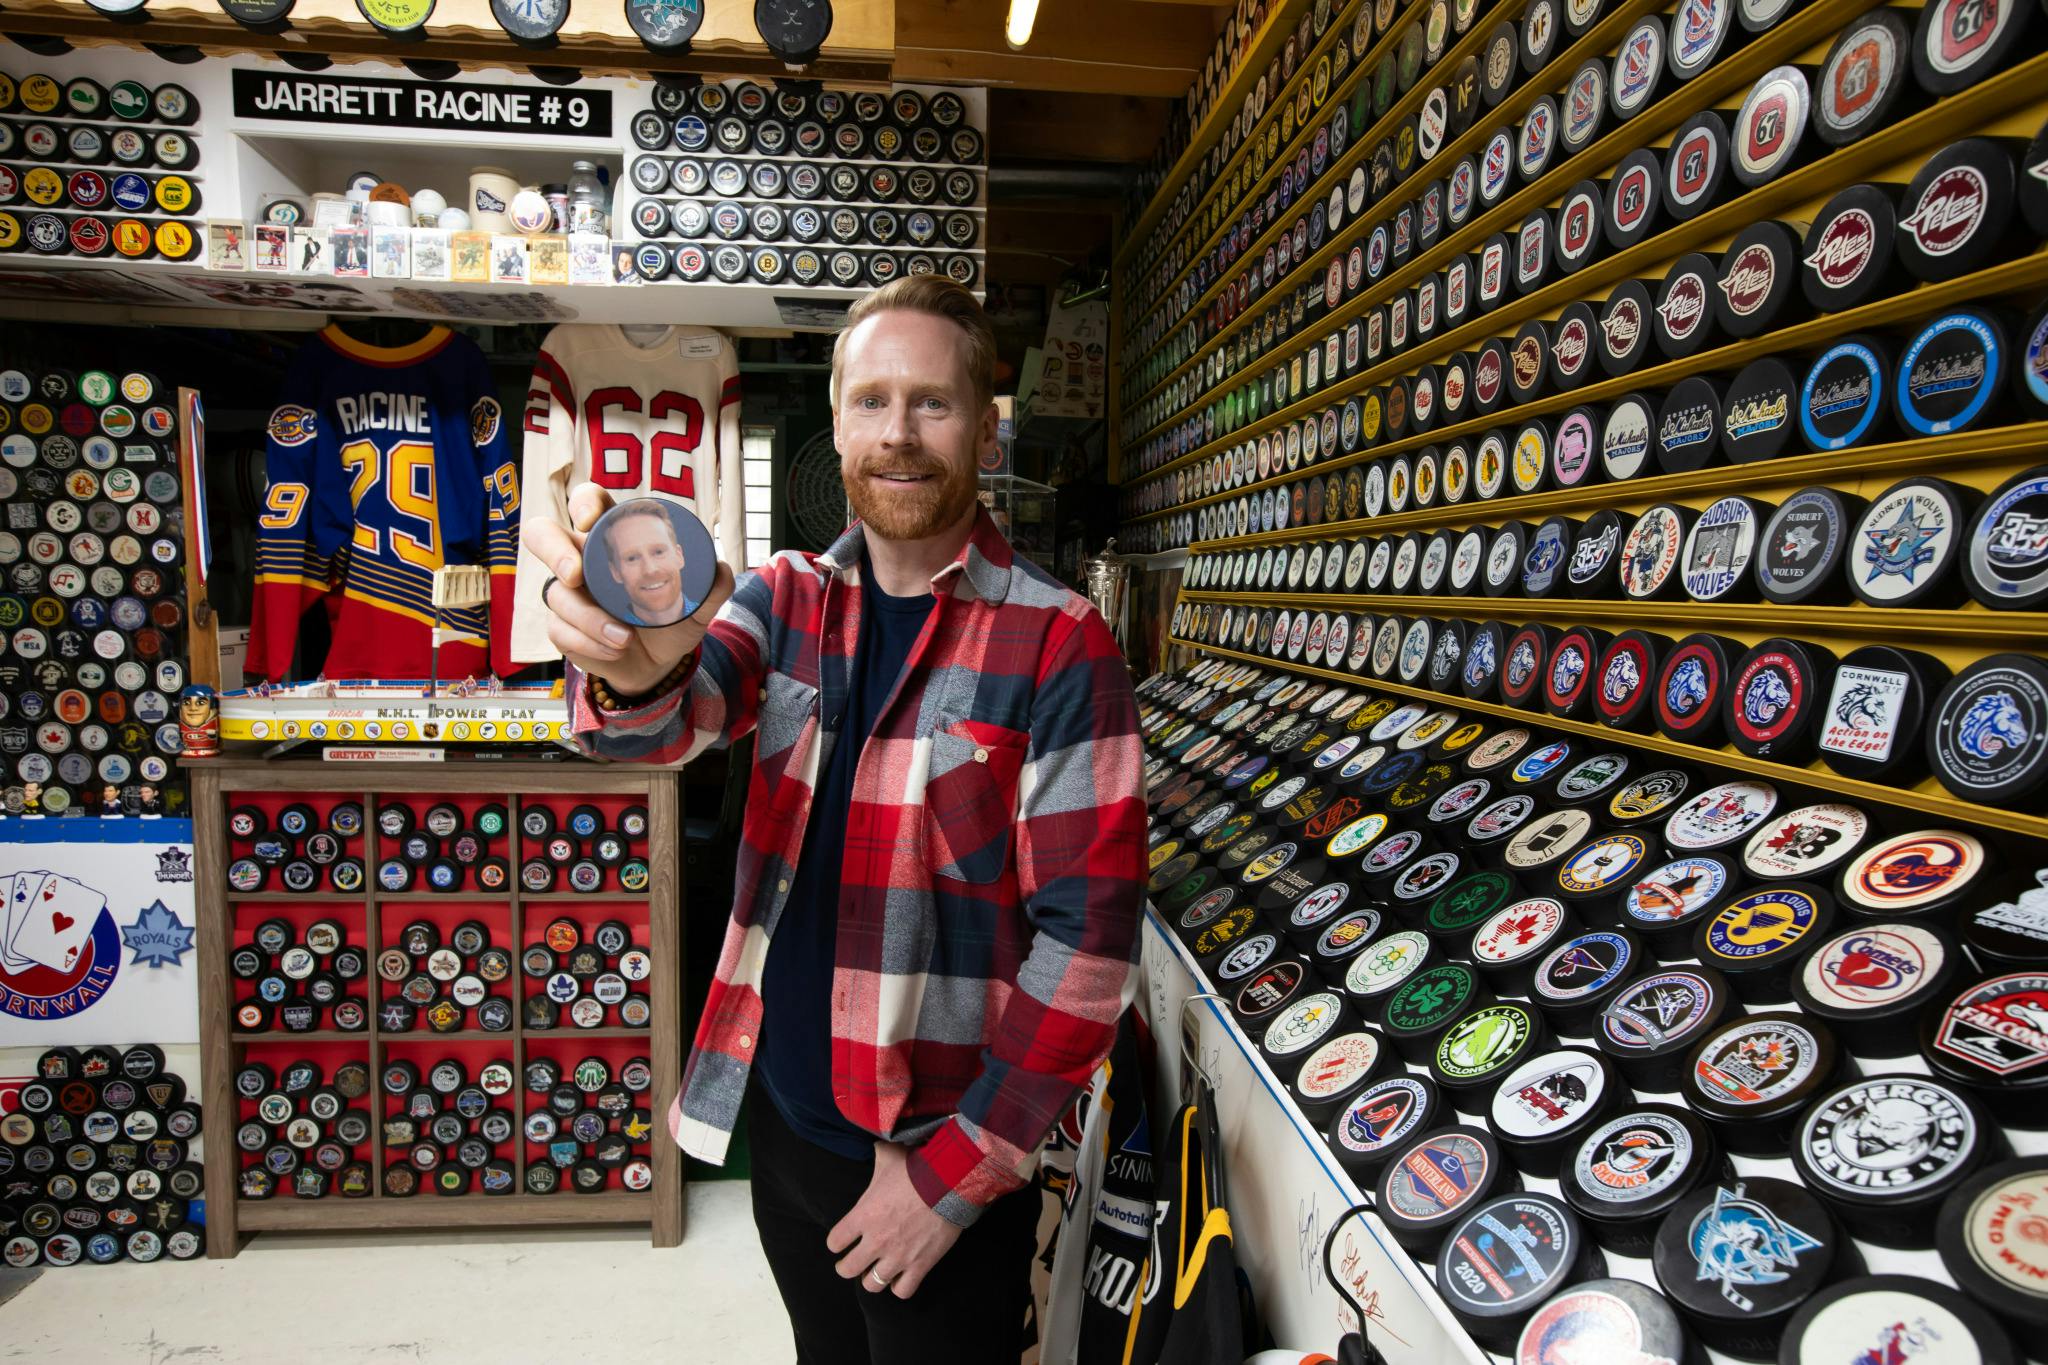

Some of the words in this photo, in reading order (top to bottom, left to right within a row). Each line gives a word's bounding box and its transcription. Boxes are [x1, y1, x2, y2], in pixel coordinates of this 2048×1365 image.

[378, 1, 410, 14] JETS
[255, 81, 403, 116] JARRETT
[416, 89, 531, 123] RACINE
[1919, 192, 1980, 236] Petes
[1925, 211, 1979, 251] PETERBOROUGH
[1824, 231, 1868, 270] Petes
[1826, 246, 1871, 284] PETERBOROUGH
[1728, 268, 1769, 296] Petes
[1664, 294, 1700, 320] Petes
[1557, 338, 1584, 360] Petes
[1904, 330, 1934, 368] ONTARIO
[1935, 318, 1972, 333] HOCKEY
[1971, 320, 1995, 351] LEAGUE
[1805, 360, 1828, 392] ONTARIO
[1828, 346, 1858, 361] HOCKEY
[1858, 347, 1879, 376] LEAGUE
[1921, 378, 1972, 394] MAJORS
[336, 392, 431, 434] RACINE
[1819, 399, 1862, 416] MAJORS
[1669, 432, 1704, 446] MAJORS
[1737, 418, 1778, 435] MAJORS
[584, 387, 704, 500] 62
[1611, 444, 1641, 457] MAJORS
[340, 438, 444, 572] 29
[1699, 500, 1750, 527] SUDBURY
[1868, 496, 1908, 529] SUDBURY
[1915, 495, 1945, 528] WOLVES
[1991, 486, 2037, 518] OFFICIAL
[1786, 512, 1823, 522] SUDBURY
[2001, 519, 2037, 547] 35
[1650, 517, 1679, 590] SUDBURY
[1687, 571, 1735, 597] WOLVES
[1773, 567, 1804, 577] WOLVES
[1736, 662, 1760, 696] OFFICIAL
[1764, 656, 1784, 665] GAME
[1787, 663, 1799, 685] PUCK
[1841, 671, 1902, 686] CORNWALL
[1964, 676, 2015, 693] CORNWALL
[2016, 680, 2040, 702] COLTS
[378, 709, 419, 718] N.H.L.
[436, 709, 487, 718] POWER
[502, 709, 536, 718] PLAY
[1825, 738, 1845, 748] the
[1849, 740, 1887, 752] Edge!
[1828, 726, 1869, 737] Action
[1873, 731, 1888, 740] on
[329, 751, 376, 759] GRETZKY
[1942, 748, 1969, 782] OFFICIAL
[1971, 774, 1995, 782] GAME
[1998, 763, 2024, 781] PUCK
[1810, 814, 1847, 827] EMPIRE
[1812, 805, 1862, 839] ANNIVERSARY
[1594, 835, 1641, 861] LASALLE
[156, 872, 192, 880] THUNDER
[1754, 856, 1798, 874] HOCKEY
[1561, 868, 1604, 889] SABRES
[1513, 904, 1557, 932] PRESTON
[1755, 894, 1778, 905] ST.
[1780, 893, 1811, 918] LOUIS
[133, 933, 181, 947] ROYALS
[1371, 932, 1415, 951] HESPELER
[1582, 935, 1613, 943] FALCON
[1719, 943, 1766, 956] BLUES
[1842, 937, 1919, 976] Comets
[1246, 982, 1277, 1006] JETS
[1431, 971, 1466, 1000] HESPELER
[1642, 977, 1700, 991] FRIENDSHIP
[1689, 990, 1705, 1018] GAMES
[1290, 995, 1328, 1010] HESPELER
[1476, 1008, 1503, 1021] ST.
[1505, 1007, 1523, 1043] LOUIS
[1614, 1026, 1632, 1041] 2016
[1615, 1007, 1663, 1040] WINTERLAND
[1442, 1036, 1450, 1059] LADY
[1788, 1028, 1808, 1046] GAME
[1335, 1039, 1370, 1067] HESPELER
[1443, 1059, 1496, 1076] CYCLONES
[1362, 1080, 1416, 1099] WINTERLAND
[1396, 1114, 1419, 1136] LOUIS
[1850, 1085, 1965, 1134] FERGUS
[1603, 1117, 1646, 1135] OFFICIAL
[1649, 1117, 1674, 1131] GAME
[1592, 1162, 1648, 1188] SHARKS
[1811, 1139, 1914, 1187] DEVILS
[1411, 1155, 1457, 1200] WINTERLAND
[1514, 1203, 1562, 1251] WINTERLAND
[1454, 1261, 1486, 1295] 2020
